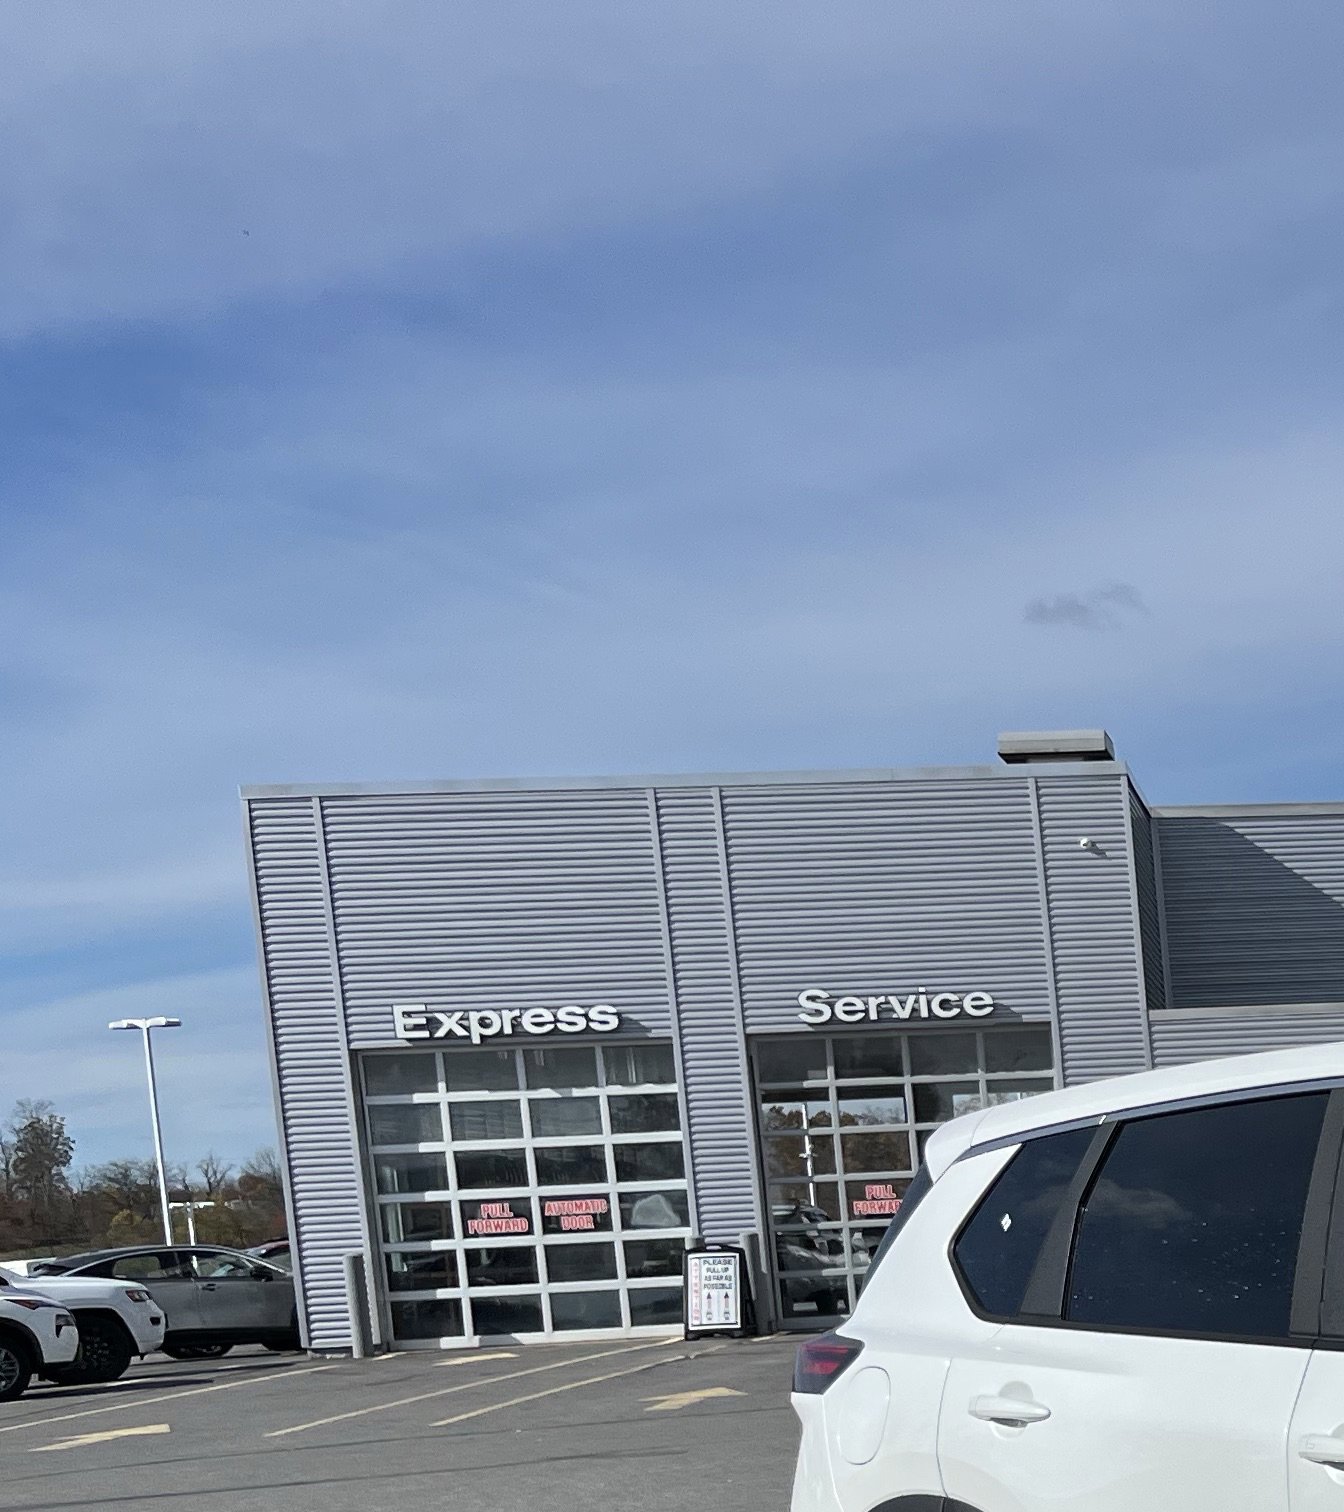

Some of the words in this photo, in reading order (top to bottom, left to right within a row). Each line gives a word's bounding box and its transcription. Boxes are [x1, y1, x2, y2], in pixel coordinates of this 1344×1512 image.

[798, 986, 995, 1024] Service
[392, 1003, 619, 1045] Express
[865, 1184, 897, 1200] PULL
[480, 1202, 513, 1219] PULL
[544, 1198, 608, 1216] AUTOMATIC
[853, 1199, 903, 1215] FORWAR
[467, 1218, 529, 1234] FORWARD
[560, 1215, 595, 1231] DOOR
